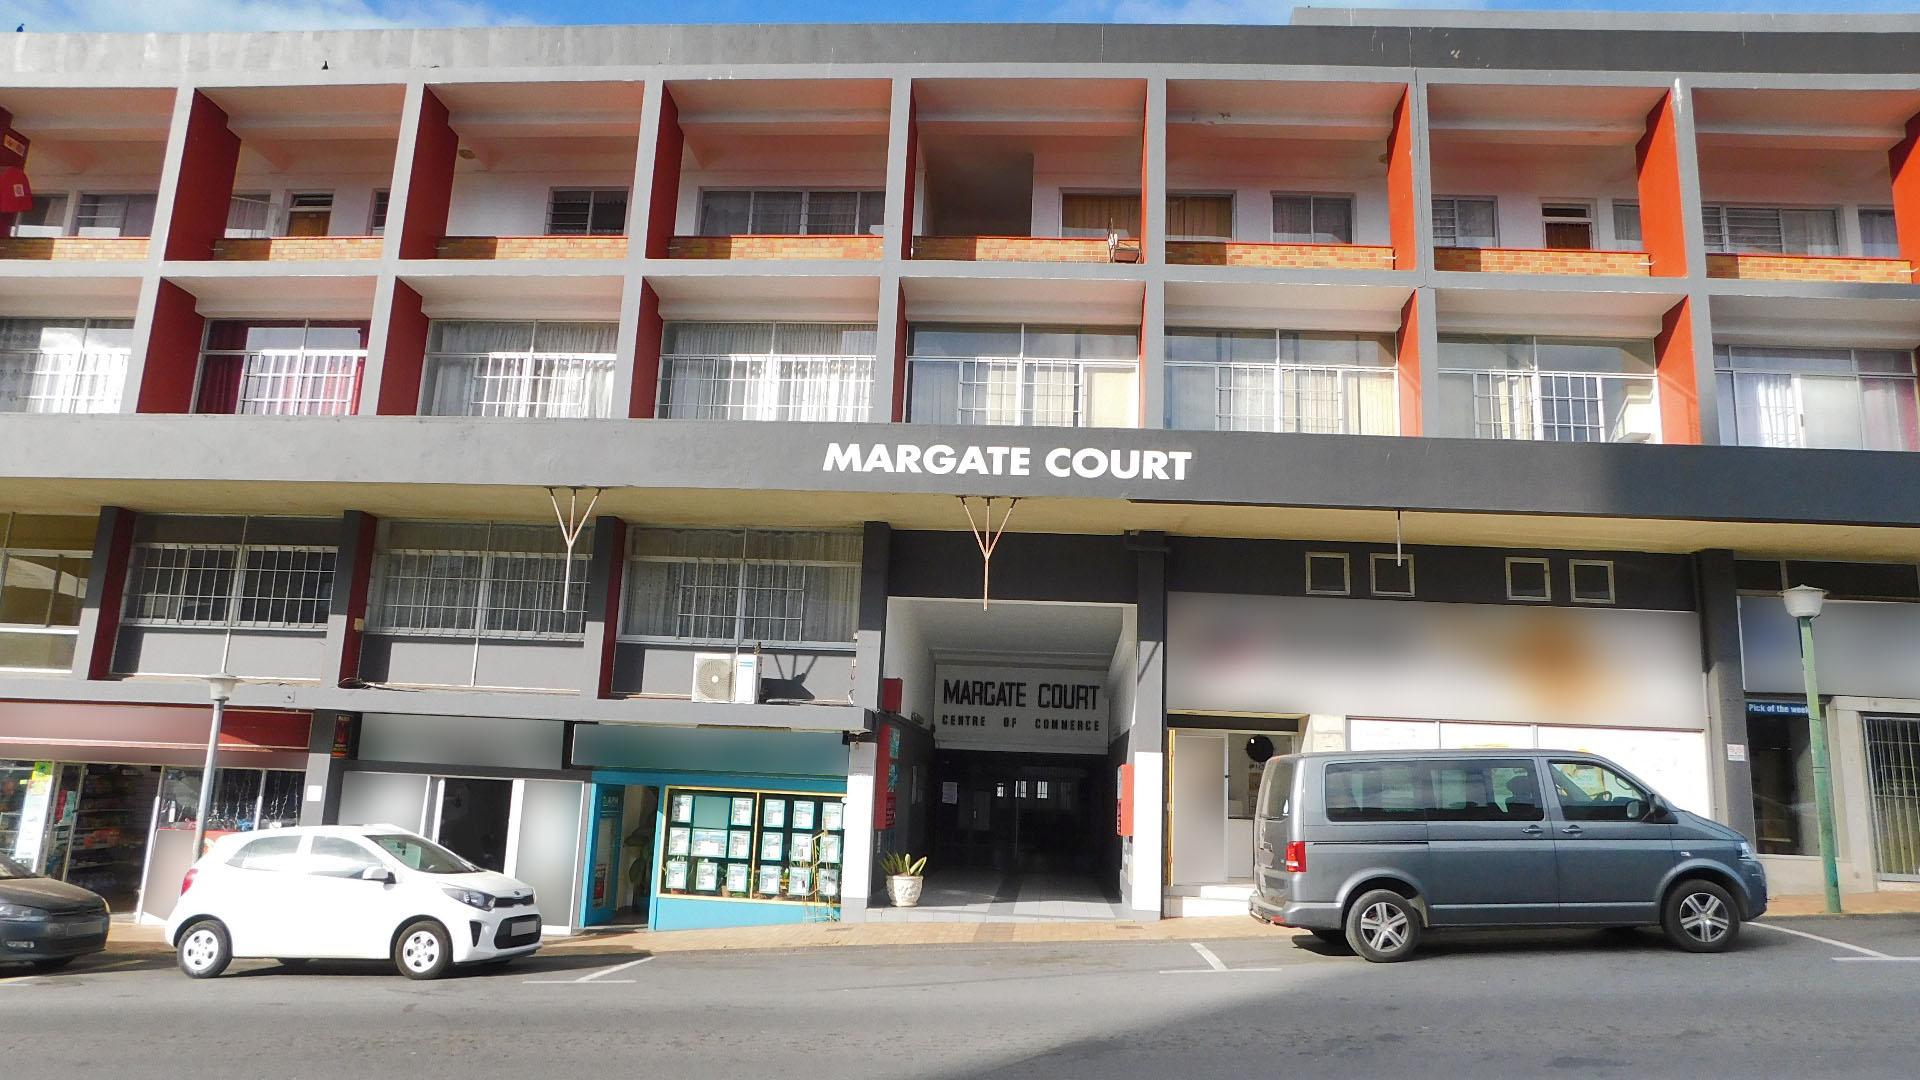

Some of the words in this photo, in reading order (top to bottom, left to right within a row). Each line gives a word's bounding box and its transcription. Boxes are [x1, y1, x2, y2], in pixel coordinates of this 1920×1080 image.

[822, 442, 1030, 476] MARGATE
[1045, 447, 1192, 481] COURT
[943, 679, 1027, 707] MARGATE
[1037, 683, 1100, 710] COURT
[1748, 703, 1765, 712] Pick
[1766, 704, 1775, 712] of
[1776, 704, 1789, 713] the
[942, 714, 986, 727] CENTRE
[1003, 717, 1017, 728] OF
[1035, 718, 1100, 731] COMMERCE
